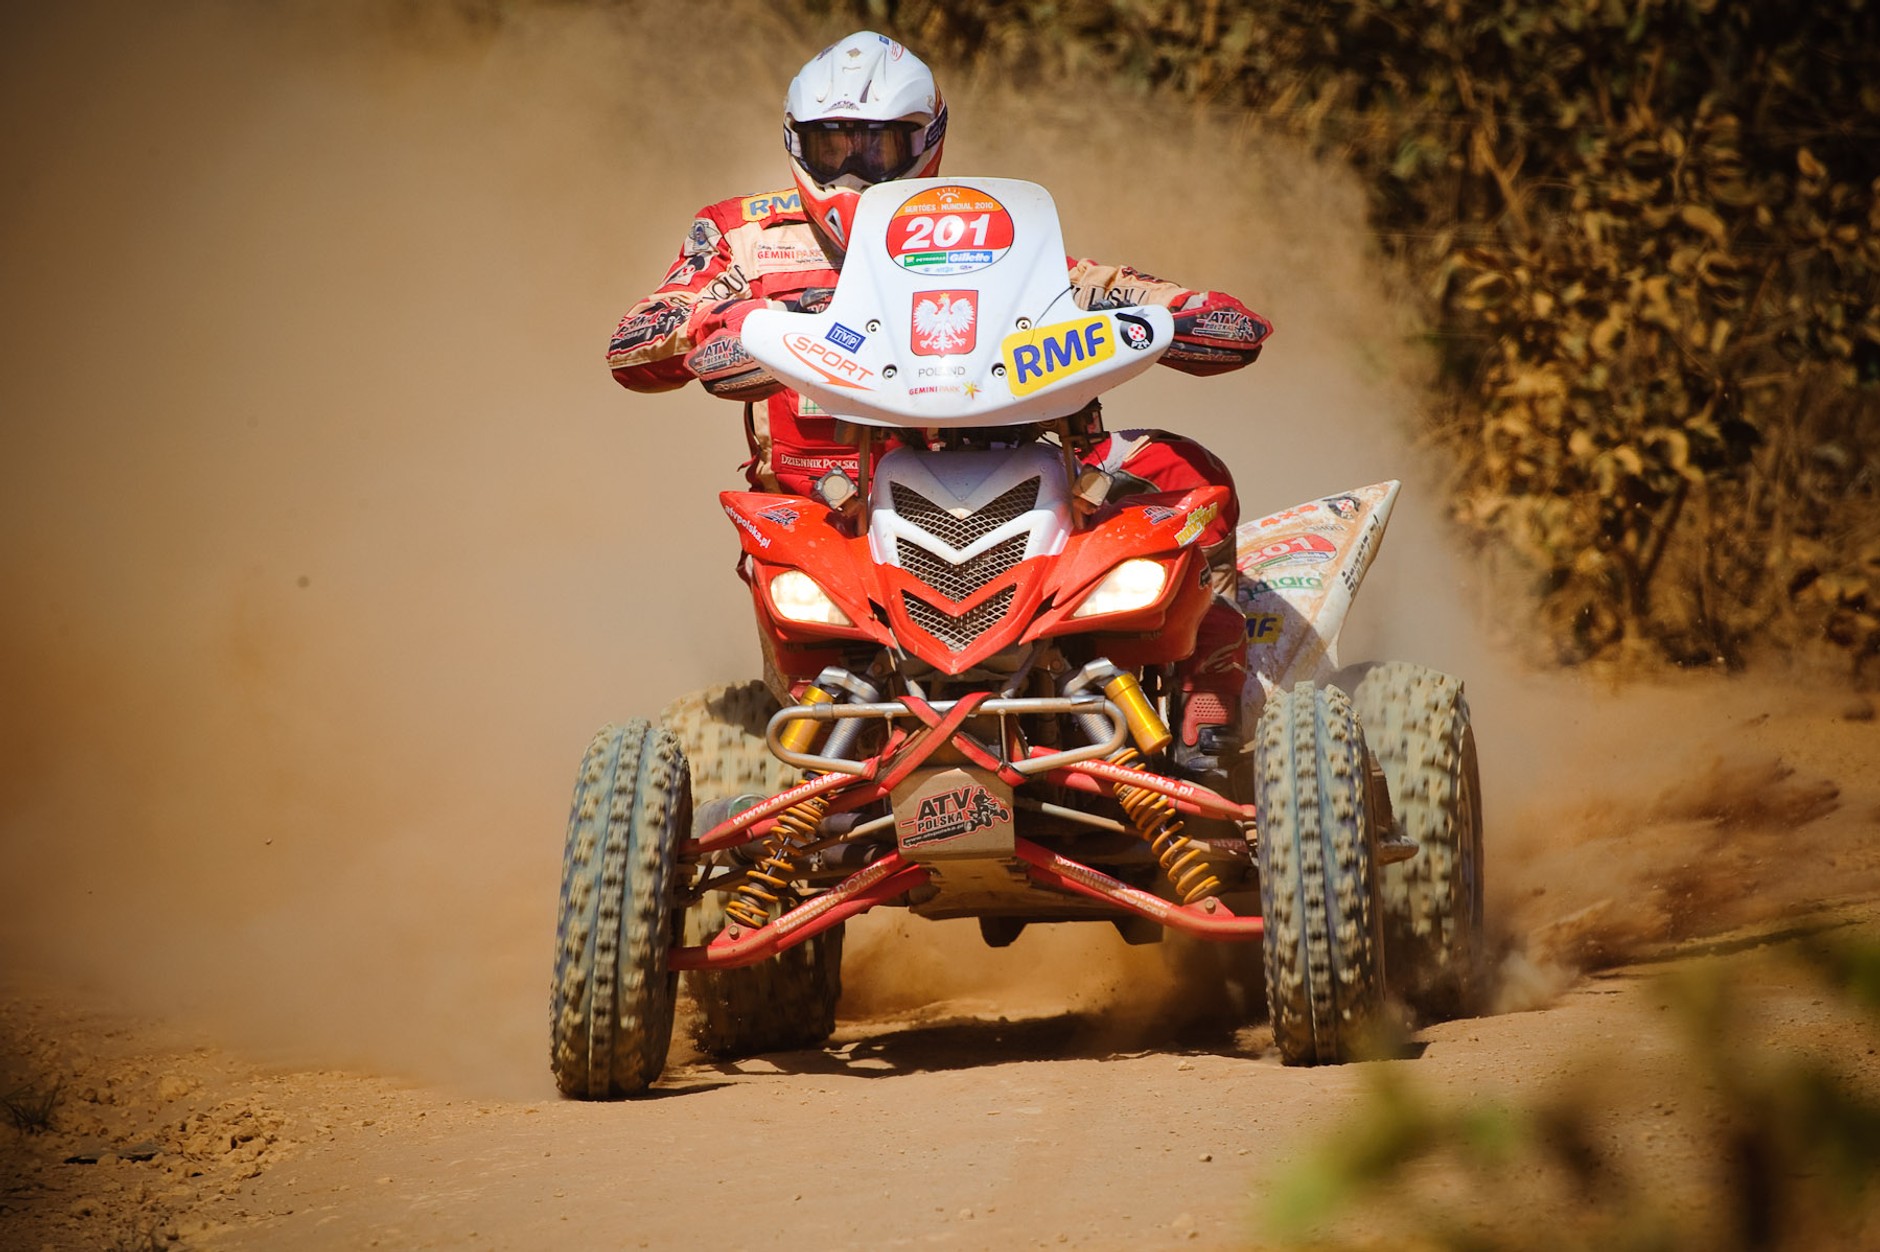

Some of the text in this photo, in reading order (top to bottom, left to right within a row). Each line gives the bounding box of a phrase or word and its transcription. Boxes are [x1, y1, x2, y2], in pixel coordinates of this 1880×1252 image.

[941, 202, 972, 212] MUNDIAL
[974, 202, 994, 210] 2010
[901, 213, 991, 251] 201
[757, 249, 795, 260] GEMINI
[948, 252, 991, 263] Gillette
[1210, 312, 1241, 324] ATV
[833, 328, 858, 348] TVP
[704, 339, 732, 359] ATV
[792, 336, 875, 382] SPORT
[1012, 321, 1105, 384] RMF
[918, 366, 966, 378] POLND
[908, 386, 938, 396] GEMINI
[781, 453, 823, 469] DZIENNIK
[725, 504, 772, 549] atvpolska.pl
[1236, 537, 1314, 568] 201
[917, 787, 971, 821] ATV
[917, 811, 964, 832] POLSKA
